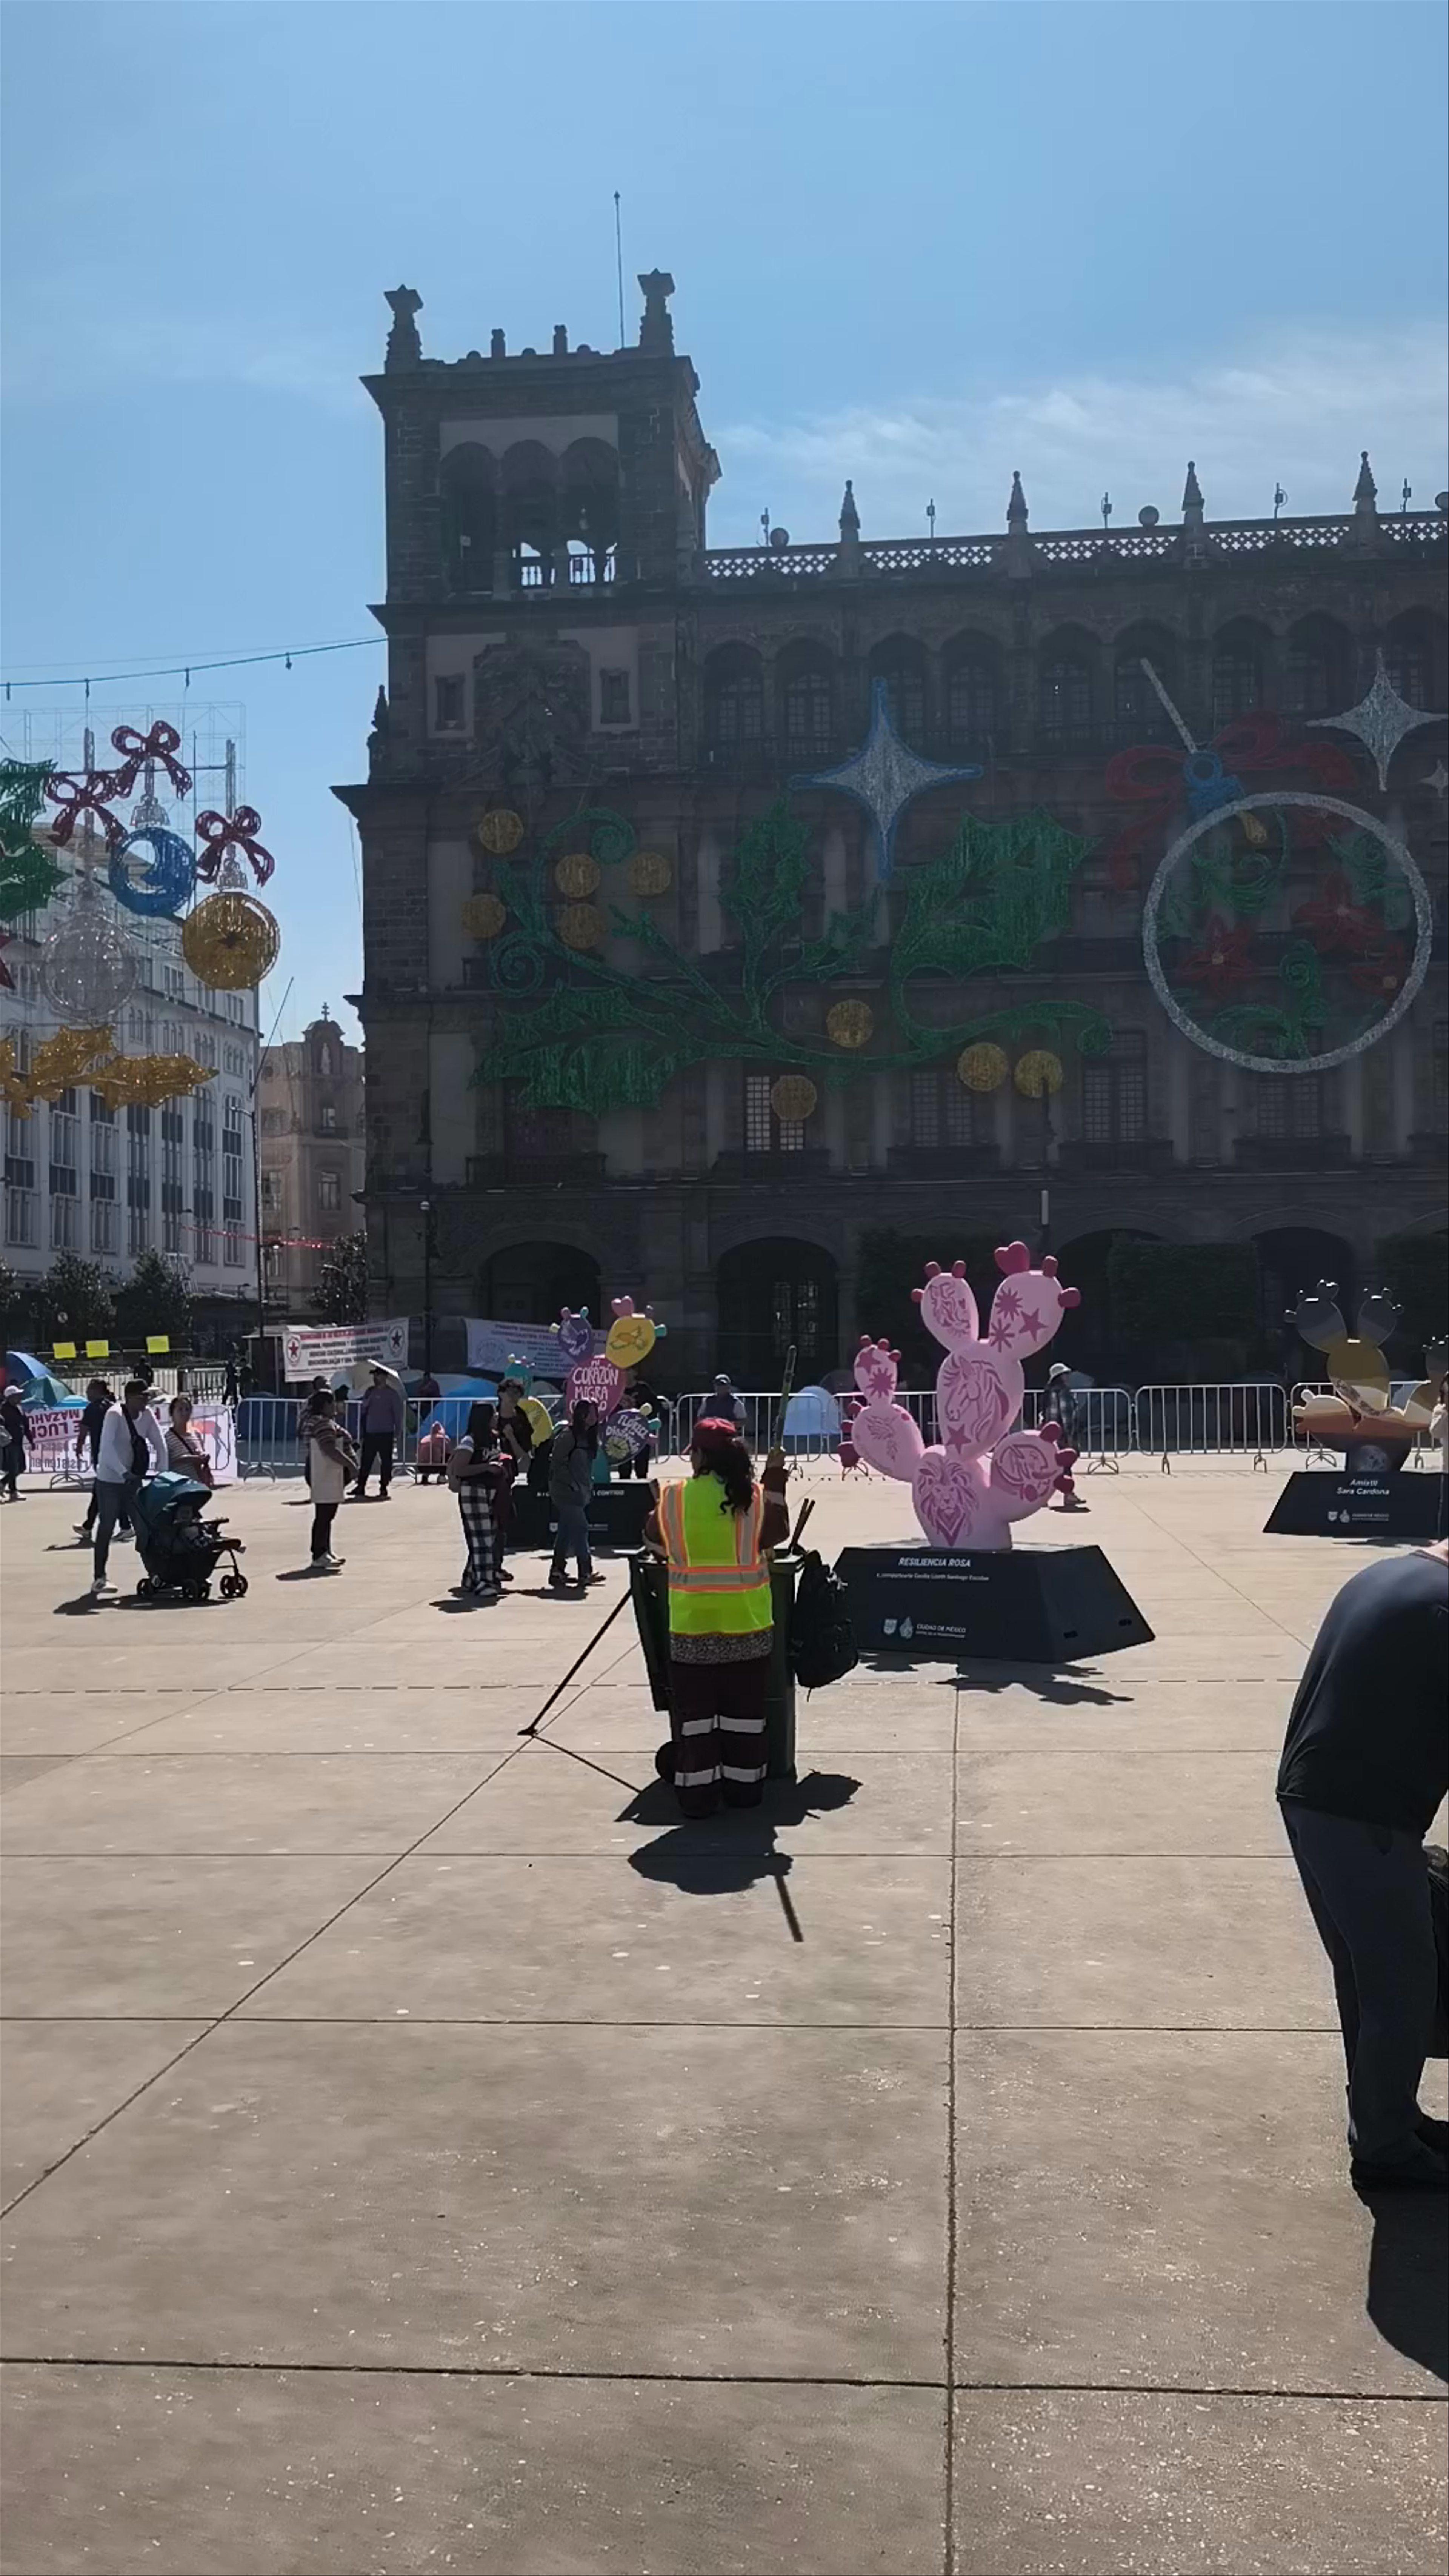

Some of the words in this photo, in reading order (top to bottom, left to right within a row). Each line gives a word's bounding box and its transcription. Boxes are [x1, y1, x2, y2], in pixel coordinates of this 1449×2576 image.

[572, 1363, 618, 1386] CORAZÓN
[575, 1386, 608, 1400] MIGRA
[28, 1409, 80, 1425] MAZAHU
[898, 1557, 946, 1567] RESILIENCIA
[948, 1558, 971, 1567] ROSA
